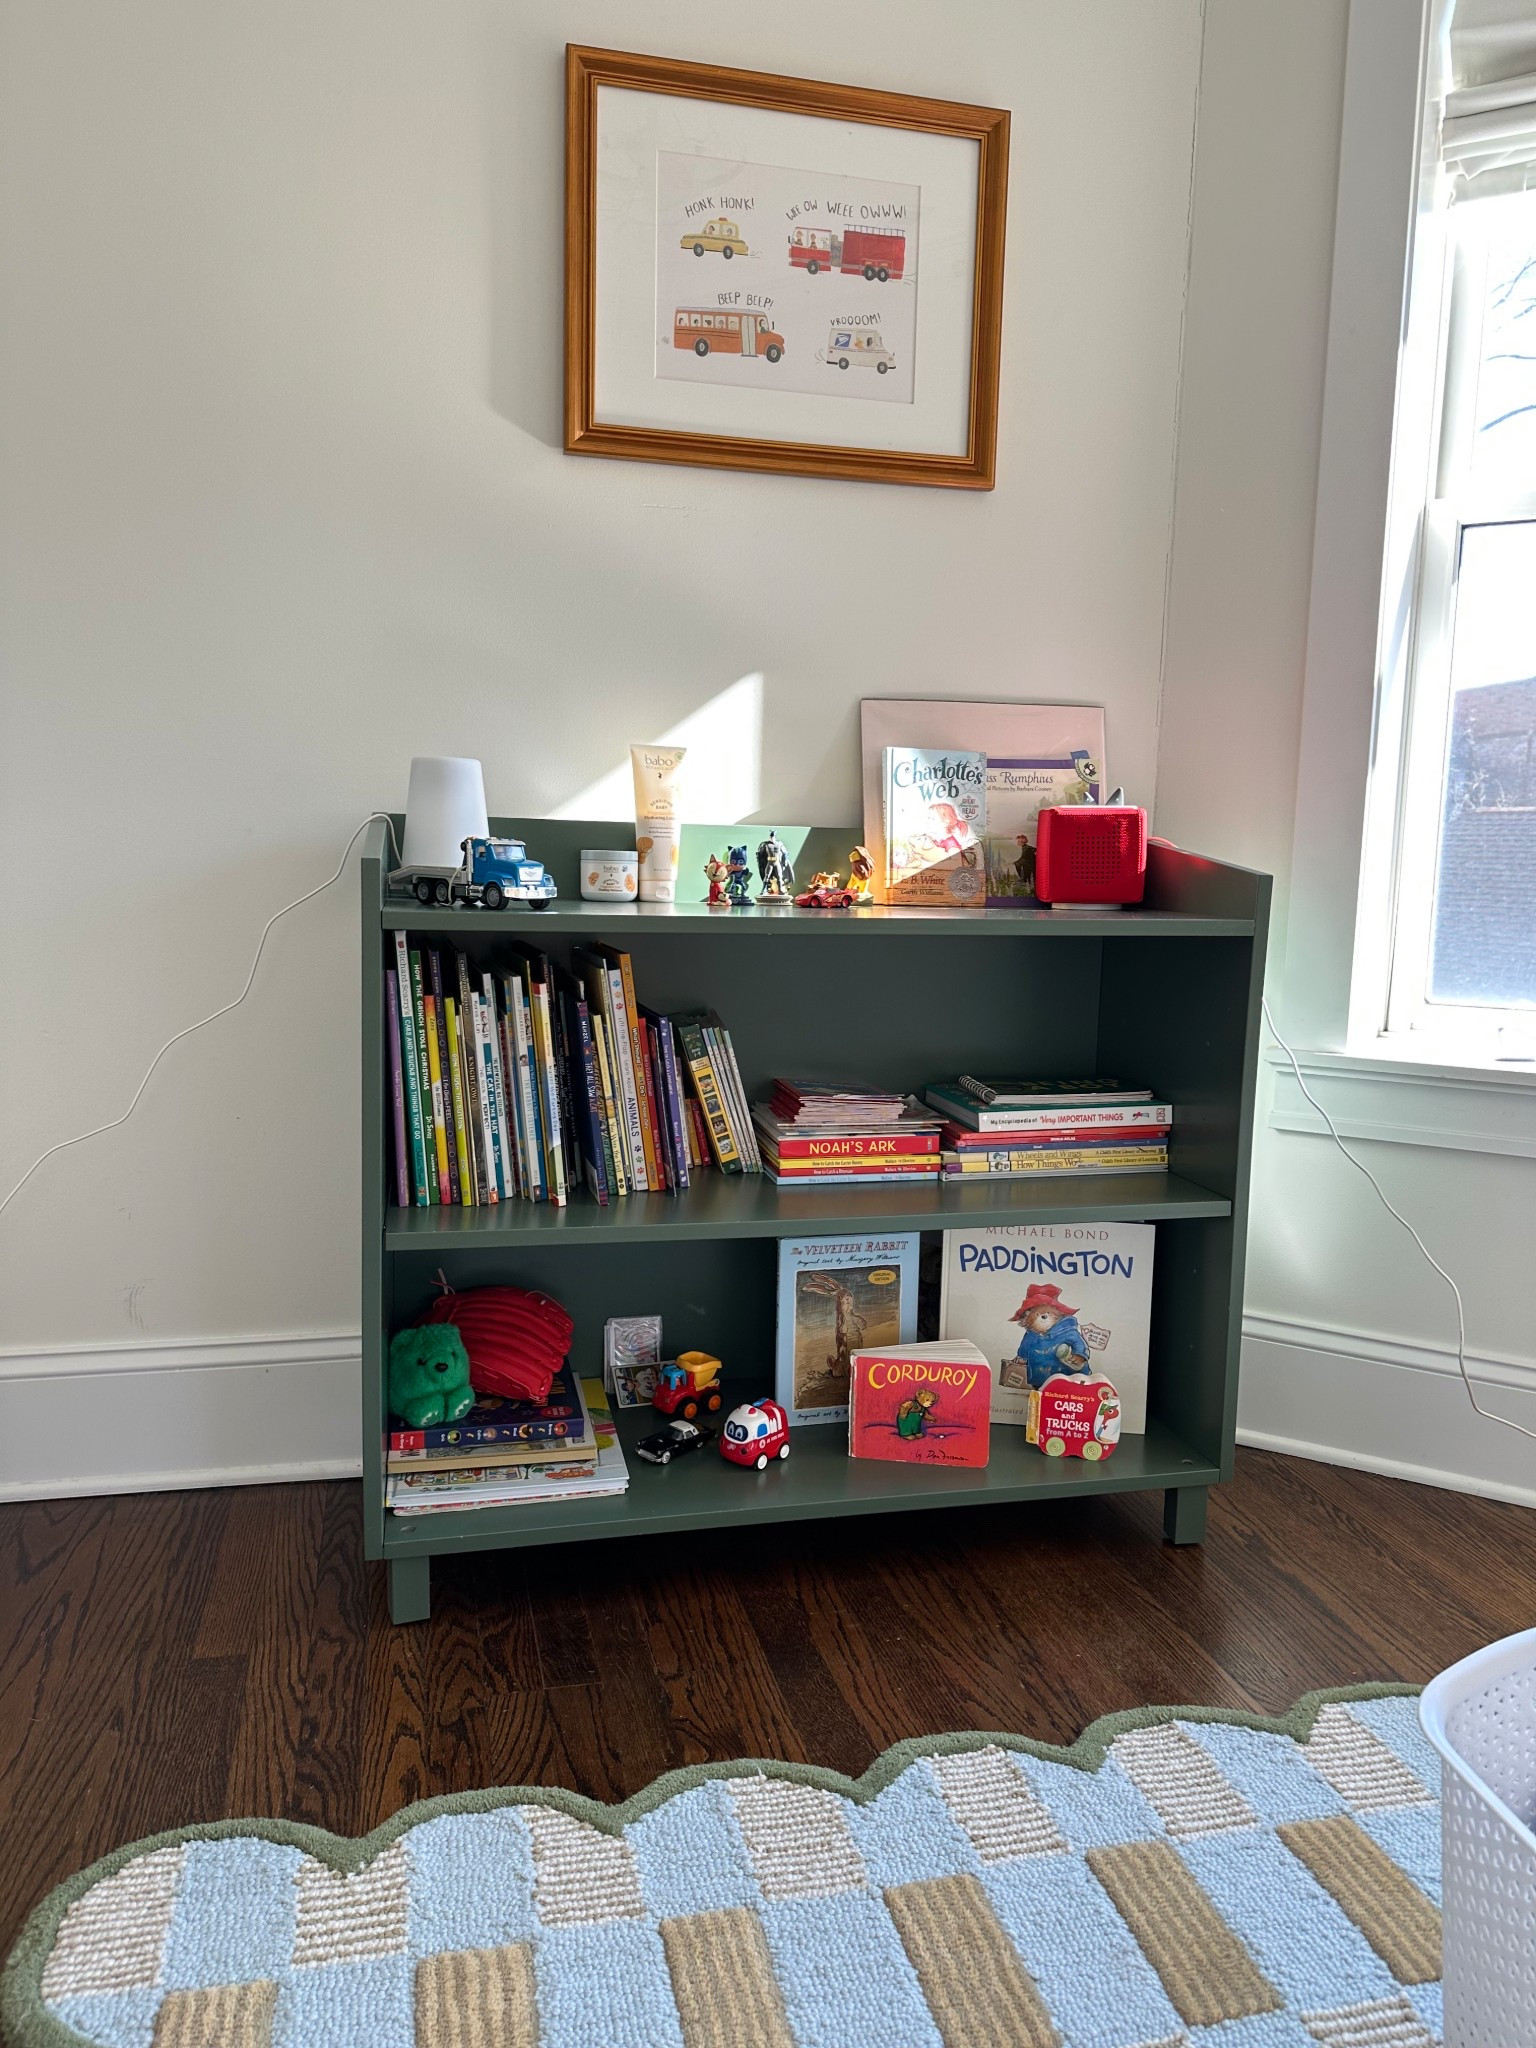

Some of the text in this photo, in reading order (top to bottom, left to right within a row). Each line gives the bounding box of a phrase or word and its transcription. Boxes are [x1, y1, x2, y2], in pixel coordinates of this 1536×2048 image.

[685, 196, 755, 218] HONK HONK!
[786, 200, 907, 221] WEE OW WEEE OWWW!
[717, 292, 774, 309] BEEP BEEP!
[830, 312, 882, 326] VROOOOM!
[644, 754, 673, 766] babo
[893, 757, 983, 787] Charlotte's
[986, 771, 1054, 786] iss Rumphius
[920, 779, 960, 801] Web
[910, 876, 919, 885] B.
[398, 949, 410, 1015] Richard Scarry's
[416, 1000, 424, 1026] GRINCH
[418, 1029, 426, 1048] STOLE
[407, 1051, 415, 1075] TRUCKS
[420, 1051, 429, 1090] CHRISTMAS
[467, 1056, 475, 1084] KNIGHT
[584, 1062, 593, 1074] THEY
[586, 1074, 594, 1084] ALL
[592, 1064, 602, 1091] Little
[587, 1085, 596, 1097] SAW
[410, 1090, 418, 1112] THINGS
[524, 1091, 532, 1112] RABBIT
[589, 1102, 597, 1113] CAT
[626, 1096, 639, 1137] ANIMALS
[1040, 1115, 1057, 1125] Very
[1057, 1114, 1096, 1123] IMPORTANT
[1097, 1113, 1123, 1121] THINGS
[414, 1130, 420, 1139] GO
[425, 1124, 434, 1139] Seuss
[526, 1113, 534, 1141] LISTENED
[610, 1133, 618, 1148] Were
[809, 1140, 896, 1155] NOAH'S ARK
[1017, 1151, 1043, 1159] Wheels
[1059, 1149, 1083, 1159] Wings
[604, 1153, 613, 1177] Could
[1017, 1159, 1063, 1169] How Things
[986, 1226, 1109, 1241] MICHAEL BOND
[790, 1240, 909, 1256] The VELVETEEN RABBIT
[959, 1243, 1134, 1278] PADDINGTON
[868, 1363, 978, 1402] CORDUROY
[1044, 1391, 1095, 1402] Richard Scarry's
[992, 1406, 1024, 1414] lustrated
[1054, 1400, 1084, 1413] CARS
[1061, 1412, 1076, 1420] and
[1045, 1417, 1090, 1432] TRUCKS
